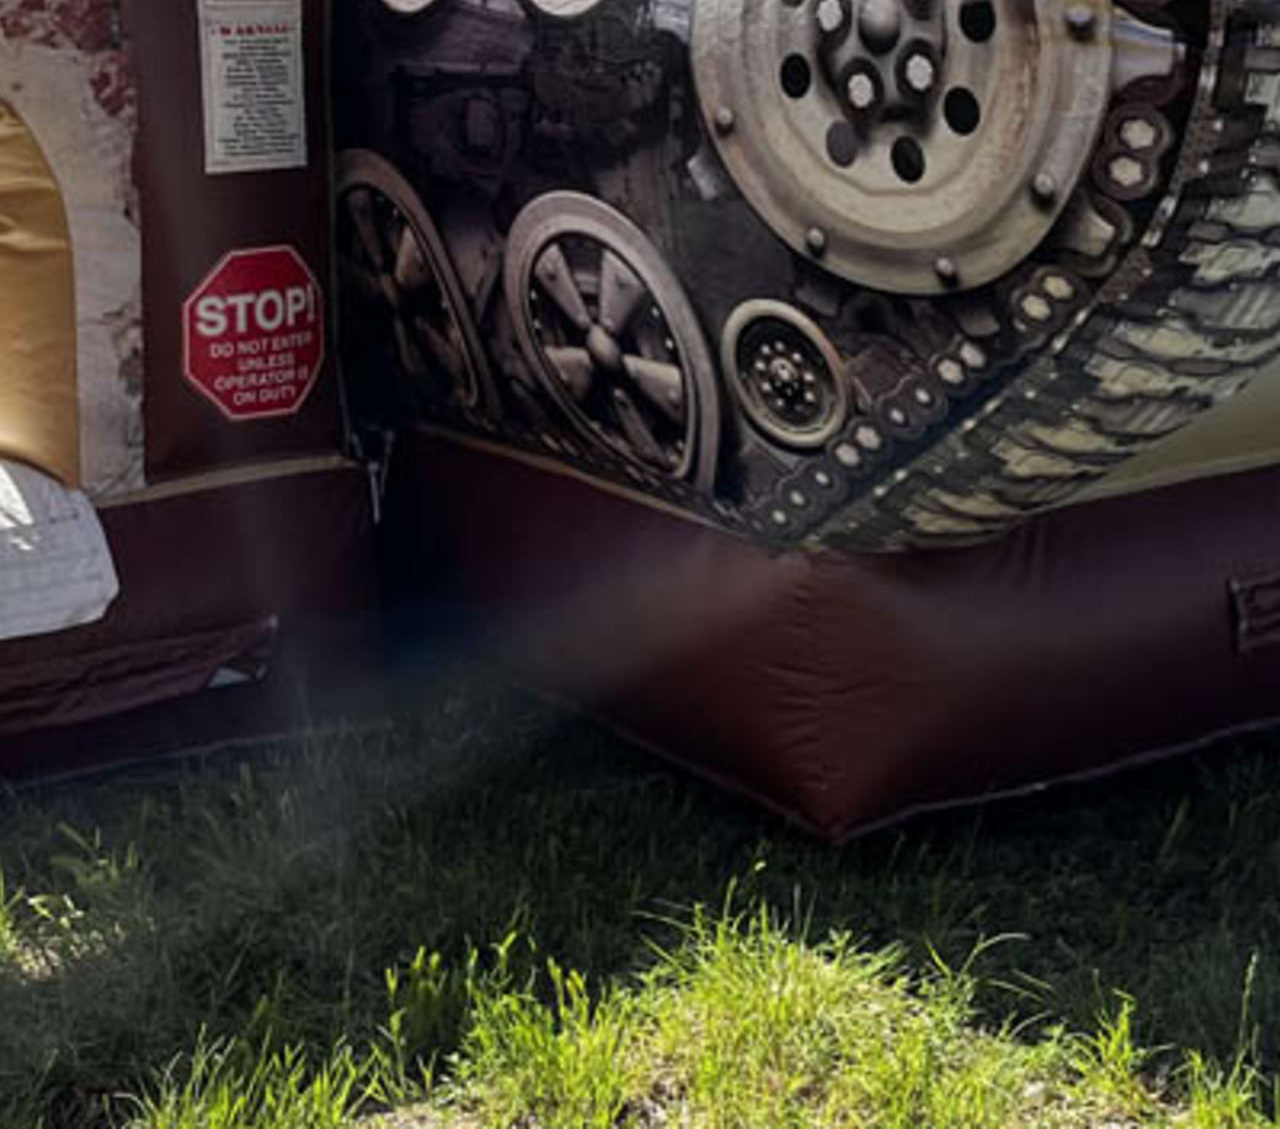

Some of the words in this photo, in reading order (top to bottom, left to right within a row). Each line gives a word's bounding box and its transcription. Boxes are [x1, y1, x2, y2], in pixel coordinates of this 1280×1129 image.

[196, 284, 315, 337] STOP!
[210, 342, 234, 358] DO
[236, 338, 269, 355] NOT
[271, 330, 312, 351] ENTER
[237, 352, 295, 372] UNLESS
[213, 368, 296, 391] OPERATOR
[297, 364, 309, 380] IS
[233, 391, 257, 406] ON
[259, 385, 296, 403] DUTY
